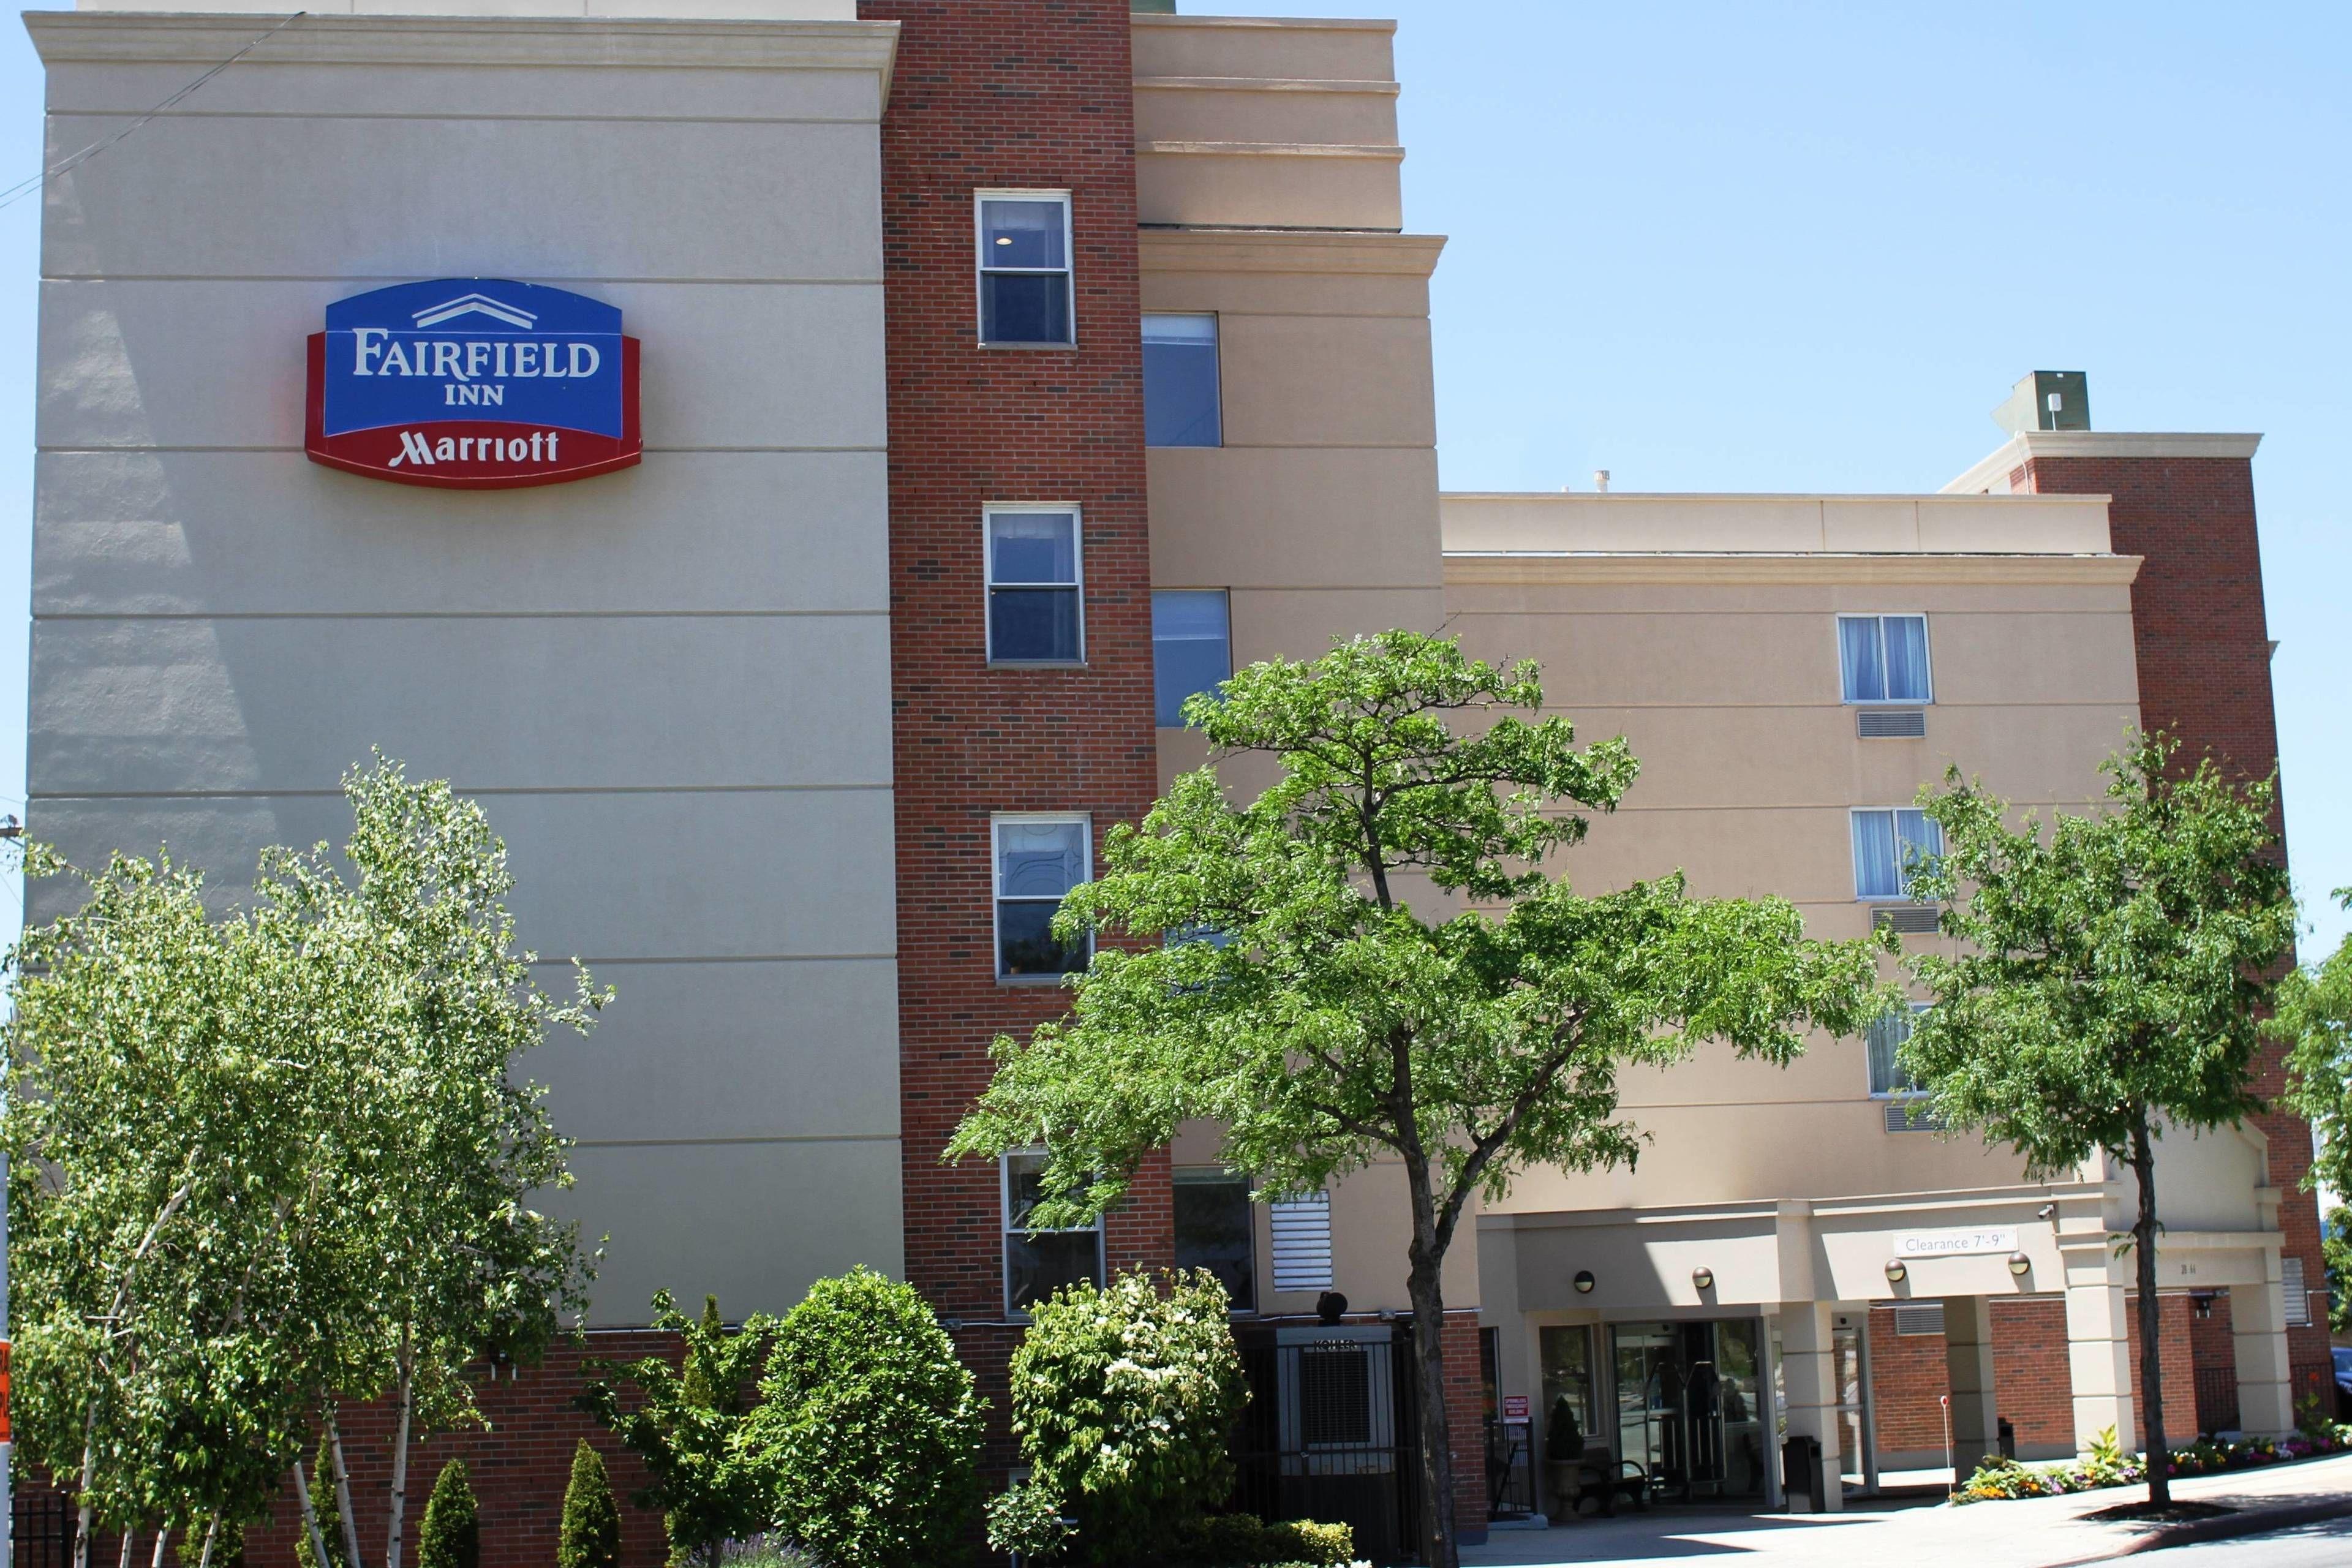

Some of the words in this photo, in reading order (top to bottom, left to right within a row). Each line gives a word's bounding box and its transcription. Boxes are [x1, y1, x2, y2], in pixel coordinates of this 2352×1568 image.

[352, 328, 600, 382] FAIRFIELD
[445, 384, 505, 406] INN
[388, 431, 559, 467] Marriott
[1905, 1237, 1969, 1251] Clearance
[1314, 1339, 1356, 1349] KOHLER
